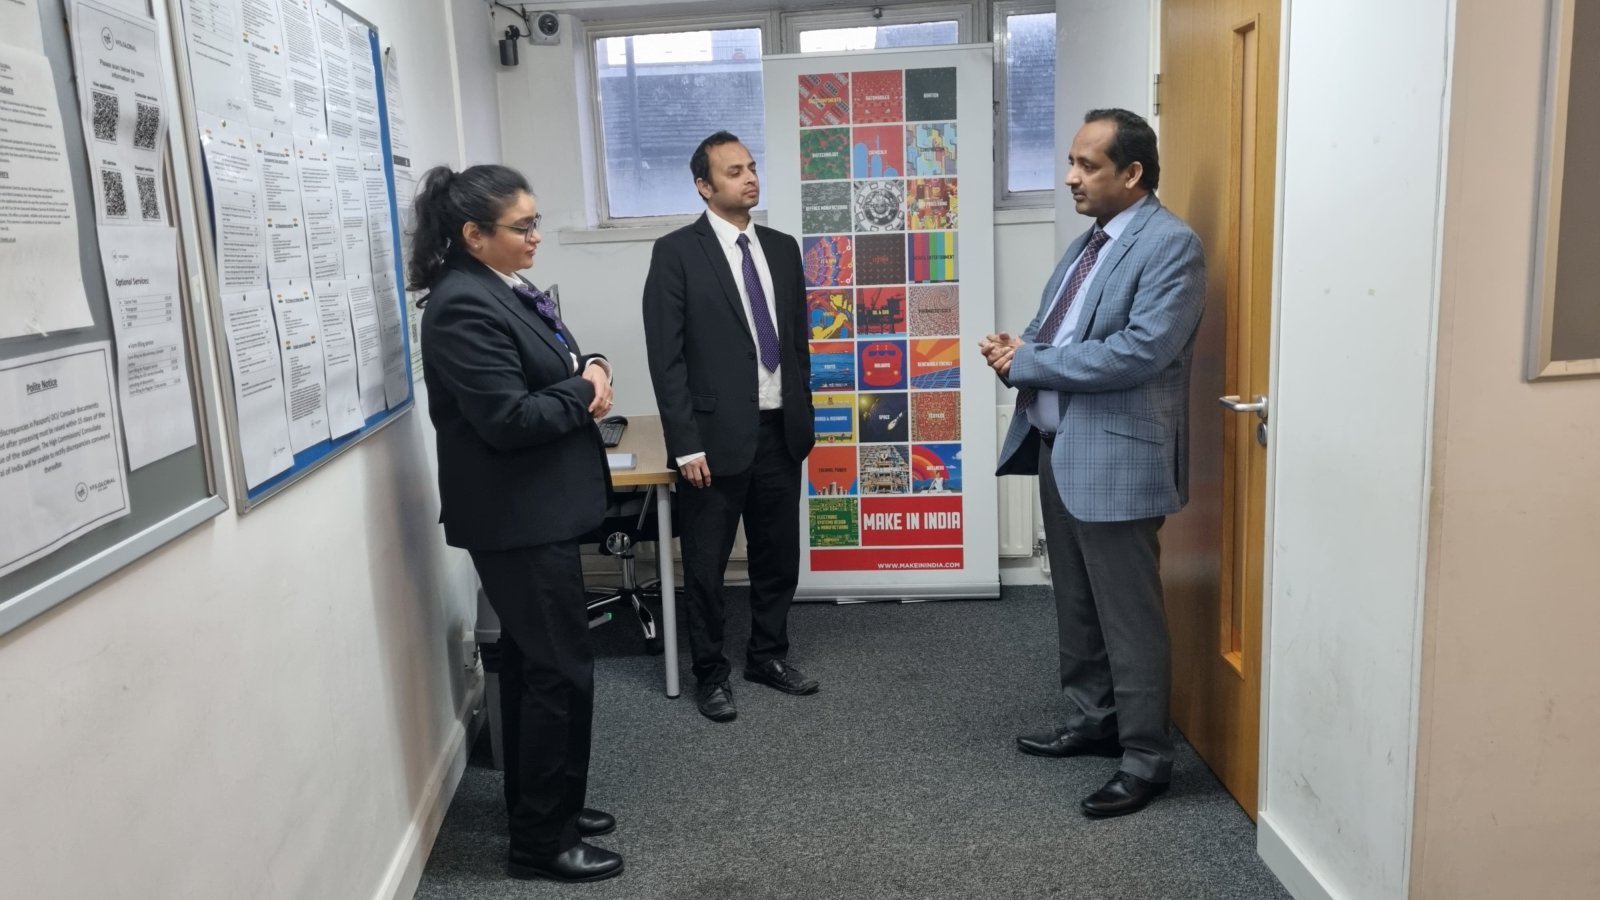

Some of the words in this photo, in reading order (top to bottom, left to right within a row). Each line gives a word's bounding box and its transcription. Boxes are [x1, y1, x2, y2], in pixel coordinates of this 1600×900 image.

[115, 278, 132, 287] Optional
[26, 382, 41, 392] Polite
[41, 378, 58, 388] Notice
[60, 408, 75, 418] Consular
[77, 403, 99, 413] documents
[6, 440, 17, 448] after
[6, 453, 10, 462] of
[12, 452, 20, 460] the
[6, 466, 10, 475] of
[11, 464, 24, 473] India
[863, 513, 902, 530] MAKE
[906, 513, 920, 530] IN
[924, 512, 961, 530] INDIA
